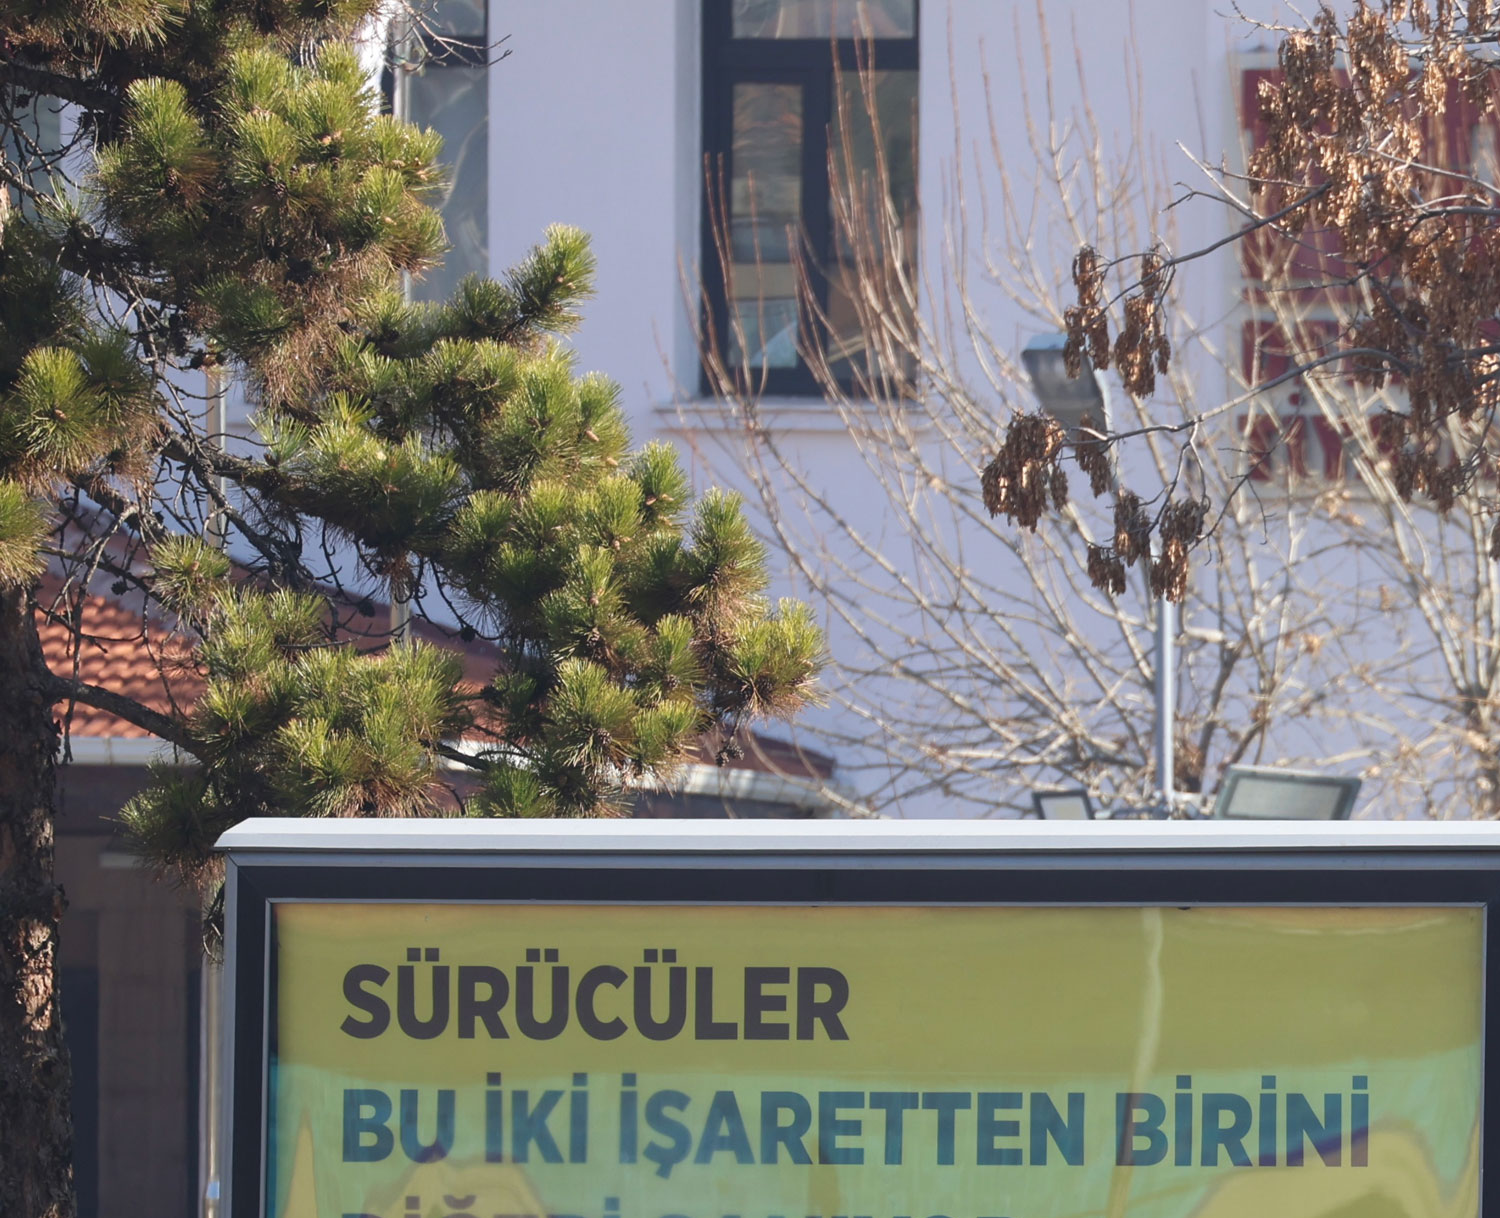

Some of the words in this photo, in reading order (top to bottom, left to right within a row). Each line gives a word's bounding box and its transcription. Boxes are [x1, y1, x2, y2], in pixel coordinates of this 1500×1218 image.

[339, 946, 850, 1041] SÜRÜCÜLER
[342, 1088, 456, 1164] BU
[485, 1071, 588, 1165] İKİ
[618, 1071, 1085, 1180] İŞARETTEN
[1115, 1074, 1369, 1167] BİRİNİ
